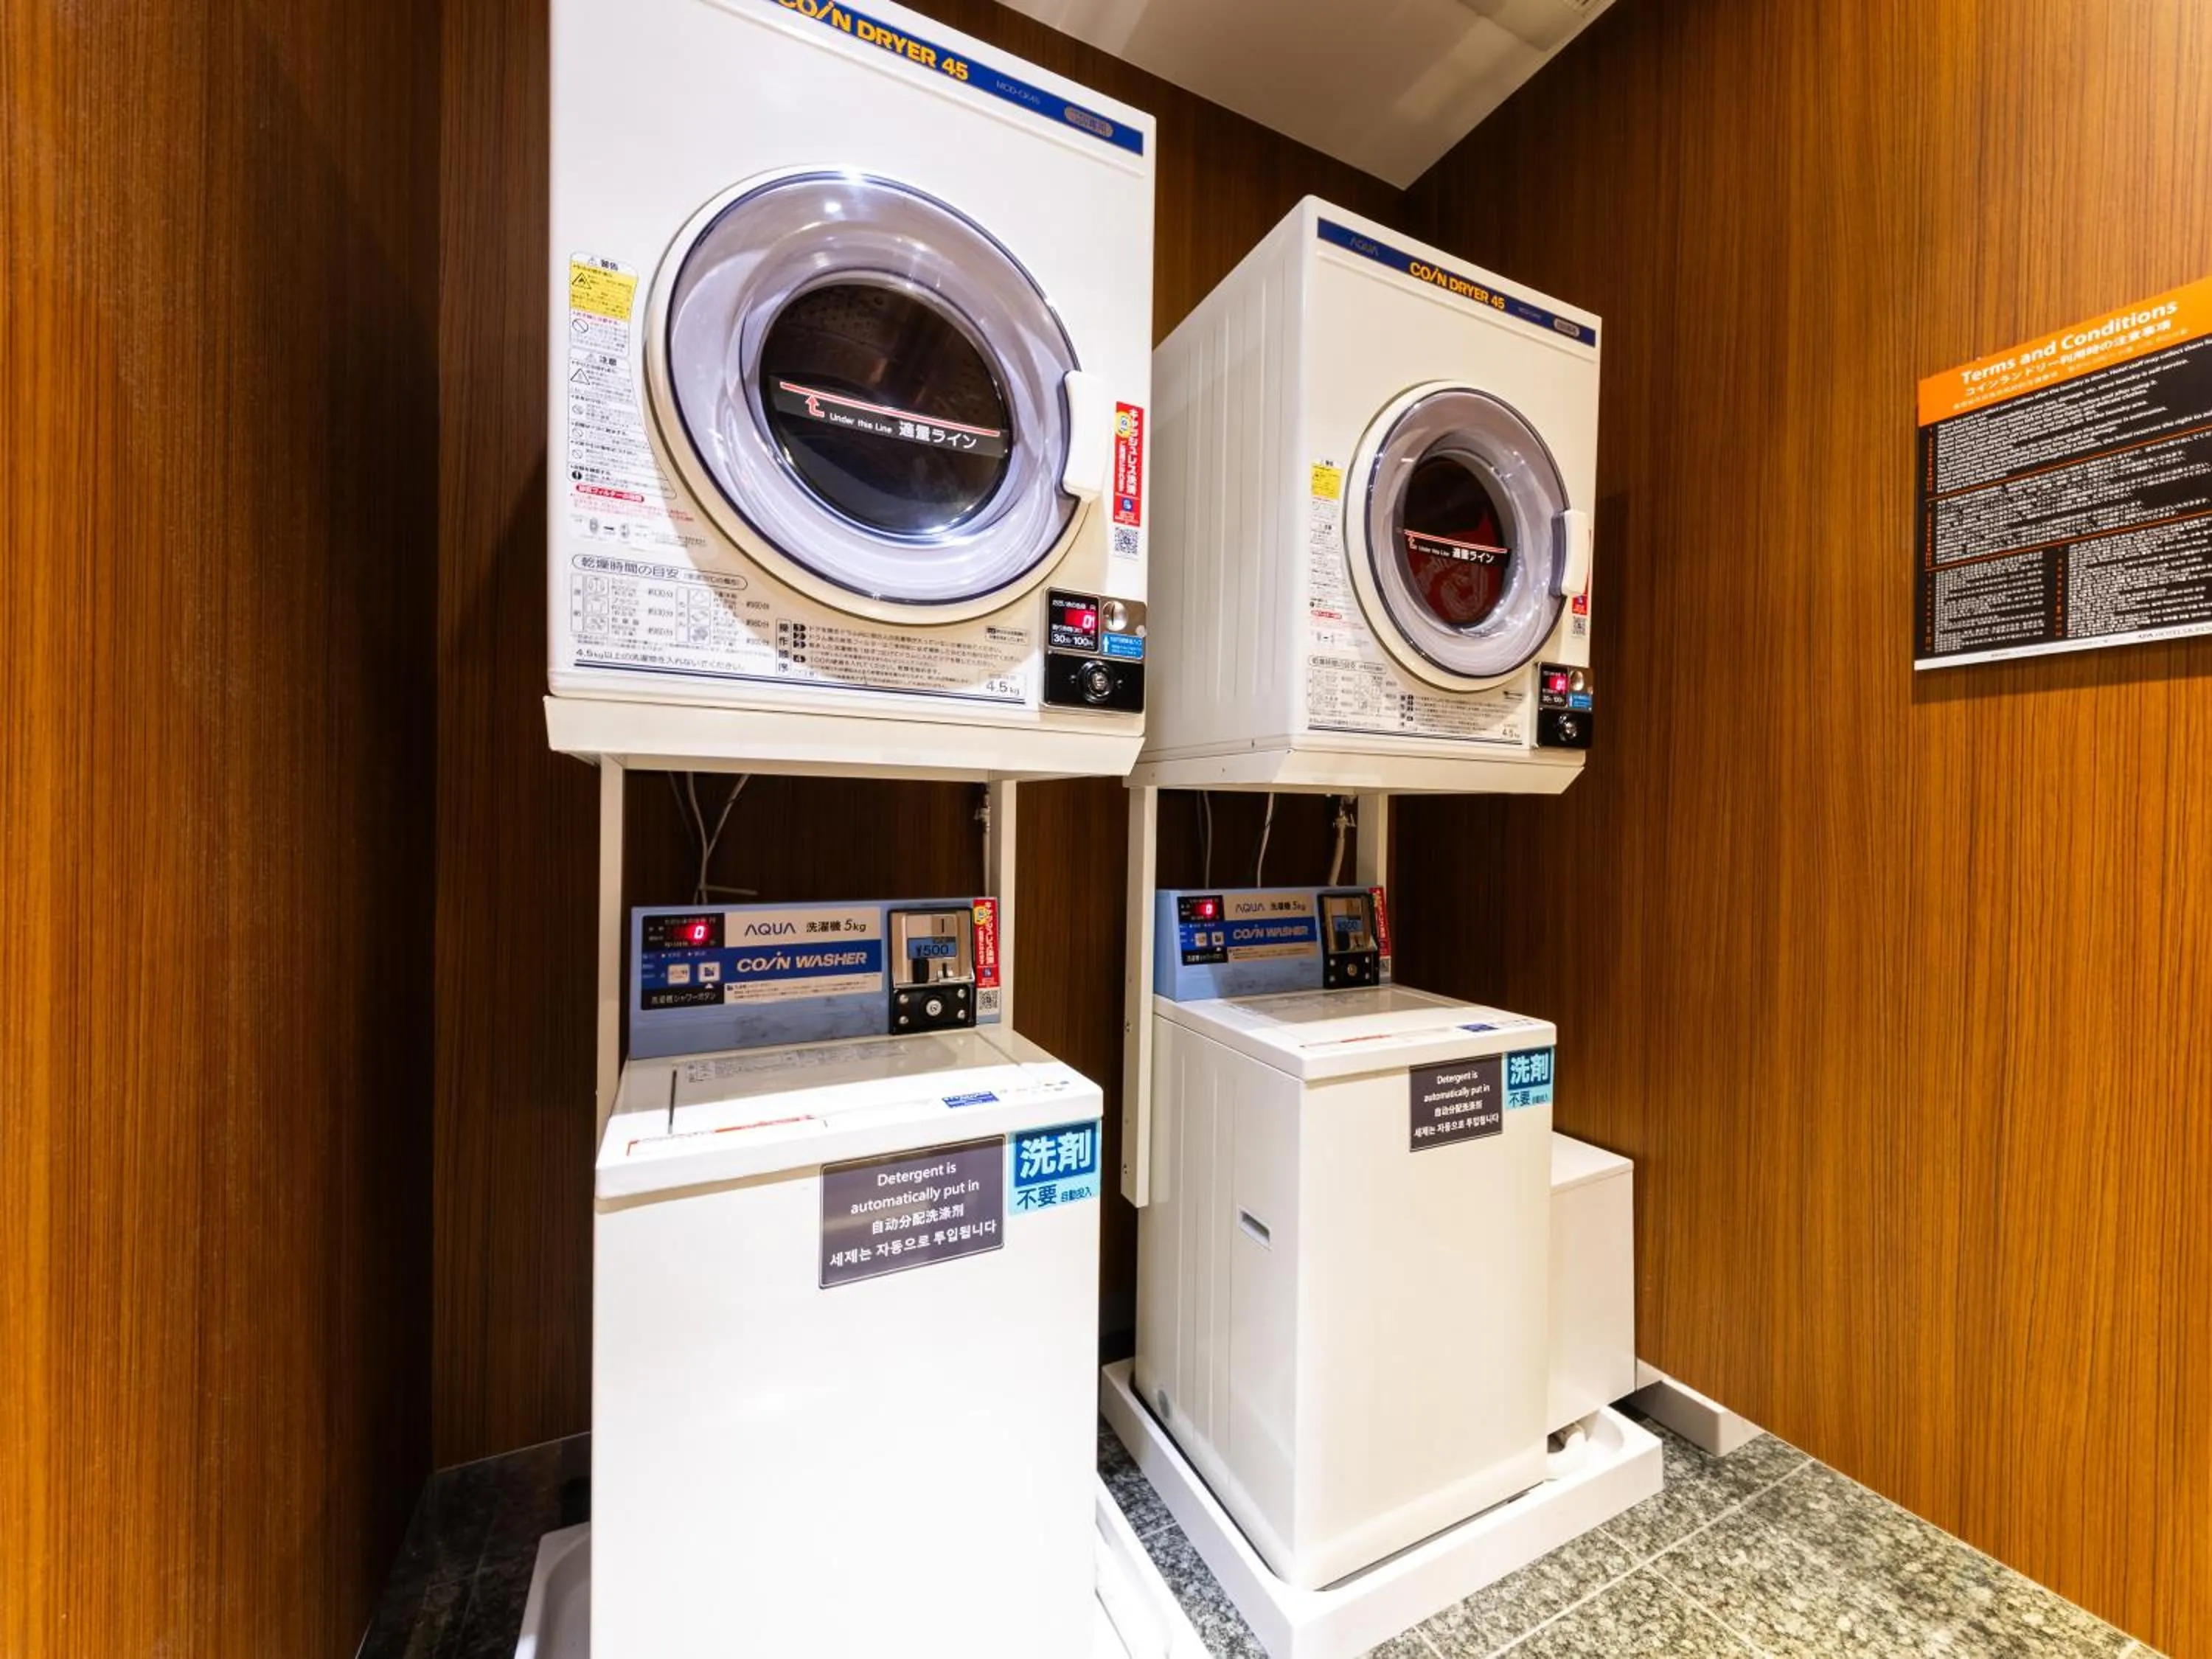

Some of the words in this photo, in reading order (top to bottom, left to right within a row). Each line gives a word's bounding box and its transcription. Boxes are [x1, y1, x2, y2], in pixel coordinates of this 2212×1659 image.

[858, 20, 937, 69] DRYER
[942, 58, 969, 80] 45
[1449, 277, 1490, 304] DRYER
[1491, 294, 1505, 310] 45
[1961, 358, 2016, 383] Terms
[2020, 341, 2056, 363] and
[2061, 301, 2178, 351] Conditions
[874, 421, 892, 434] Line
[899, 420, 977, 450] 適量ライン
[580, 555, 679, 579] 乾燥時間の目安
[986, 681, 1009, 693] 4.5
[1235, 902, 1265, 914] AQUA
[694, 925, 705, 939] 0
[744, 922, 796, 937] AQUA
[806, 920, 841, 933] 洗濯機
[844, 918, 867, 933] 5kg
[1265, 925, 1309, 939] WASHER
[737, 950, 790, 973] COIN
[795, 951, 868, 969] WASHER
[1437, 1071, 1471, 1085] Detergent
[1472, 1070, 1478, 1079] is
[1510, 1053, 1549, 1085] 洗剤
[1424, 1086, 1470, 1102] automatically
[1471, 1085, 1483, 1096] put
[1483, 1083, 1490, 1093] in
[1509, 1090, 1531, 1107] 不要
[1020, 1129, 1092, 1179] 洗剤
[877, 1166, 945, 1186] Detergent
[946, 1162, 956, 1174] is
[850, 1186, 941, 1214] automatically
[943, 1182, 965, 1199] put
[968, 1179, 980, 1192] in
[1017, 1183, 1057, 1210] 不要
[830, 1248, 872, 1267] 세제는
[876, 1235, 931, 1257] 자동으로
[933, 1219, 997, 1245] 투입됩니다
